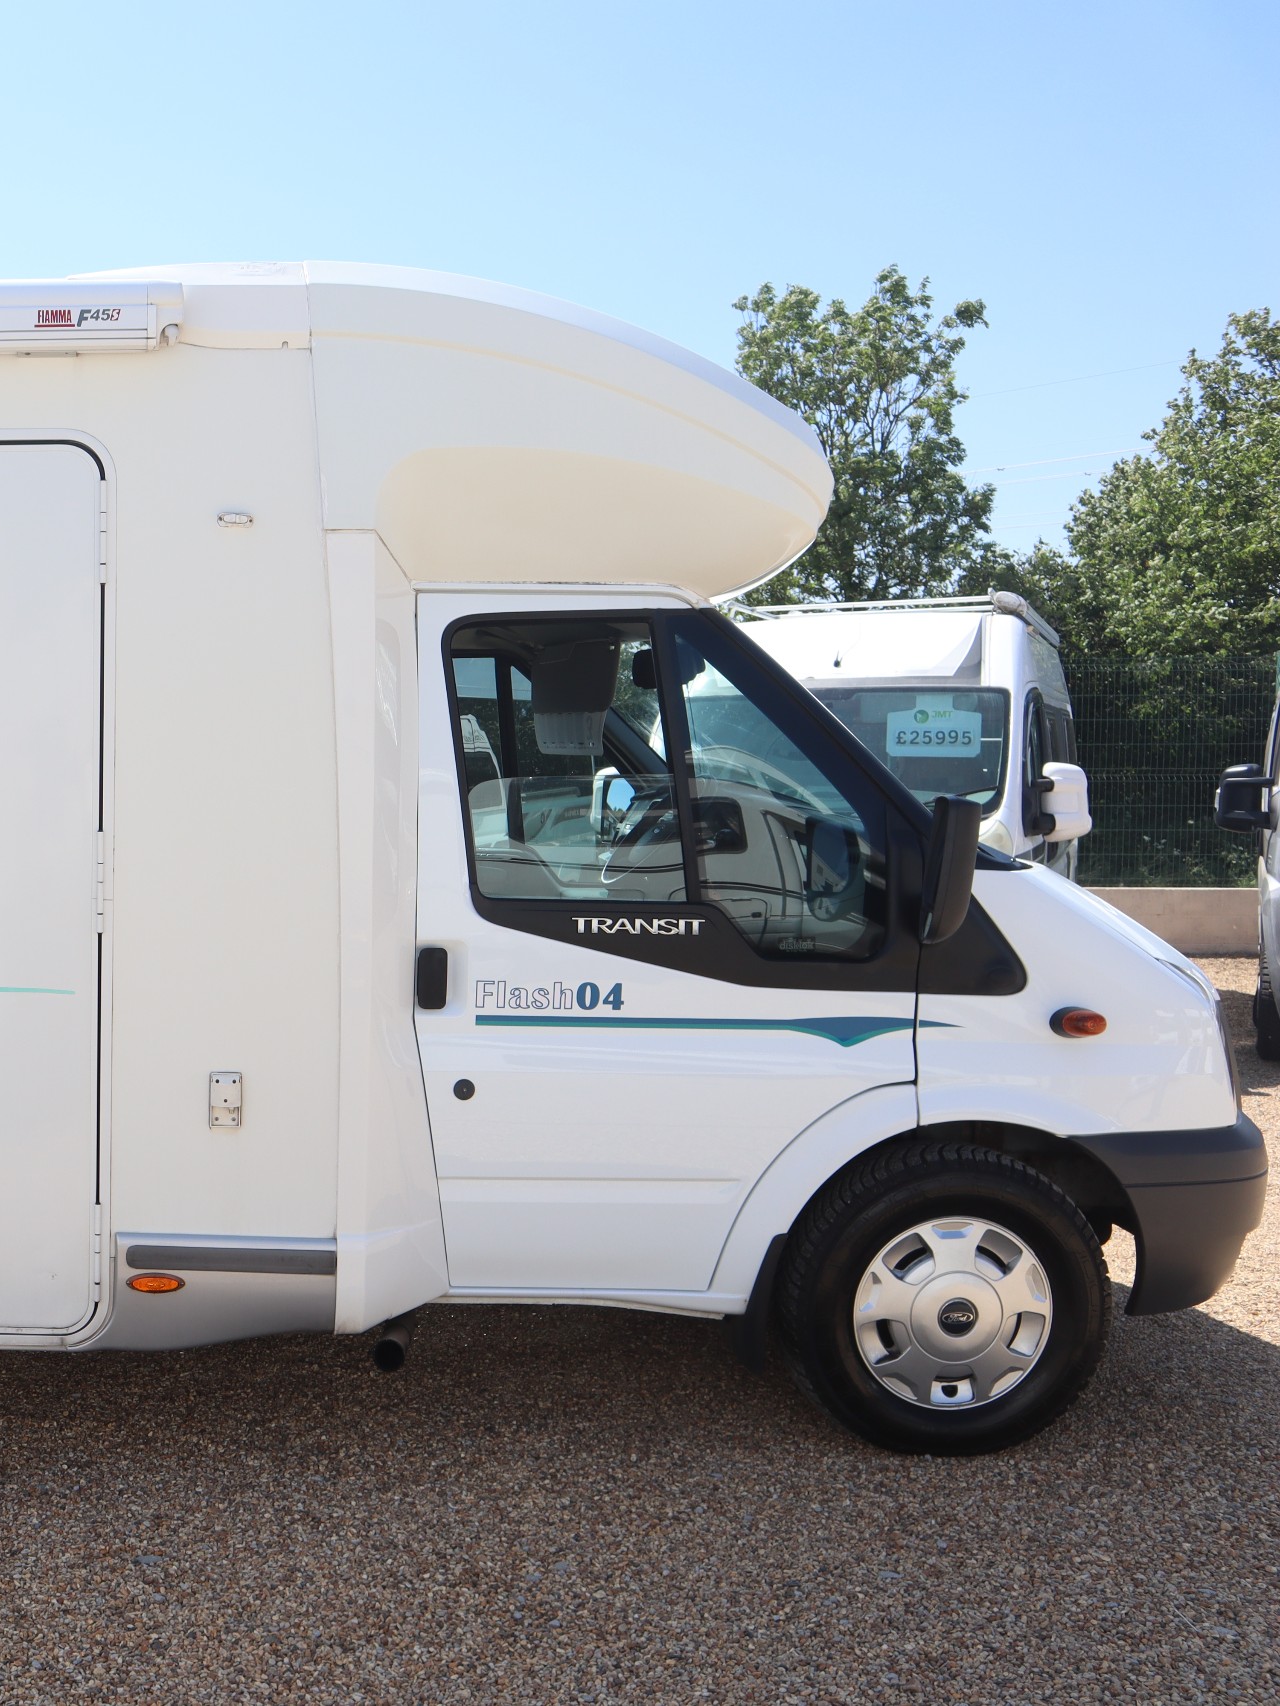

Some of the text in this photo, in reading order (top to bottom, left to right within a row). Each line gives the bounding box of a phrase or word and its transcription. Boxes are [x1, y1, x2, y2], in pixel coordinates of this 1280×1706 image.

[37, 309, 72, 324] FIAMMA
[896, 730, 972, 745] £25995
[572, 917, 706, 936] TRANSIT
